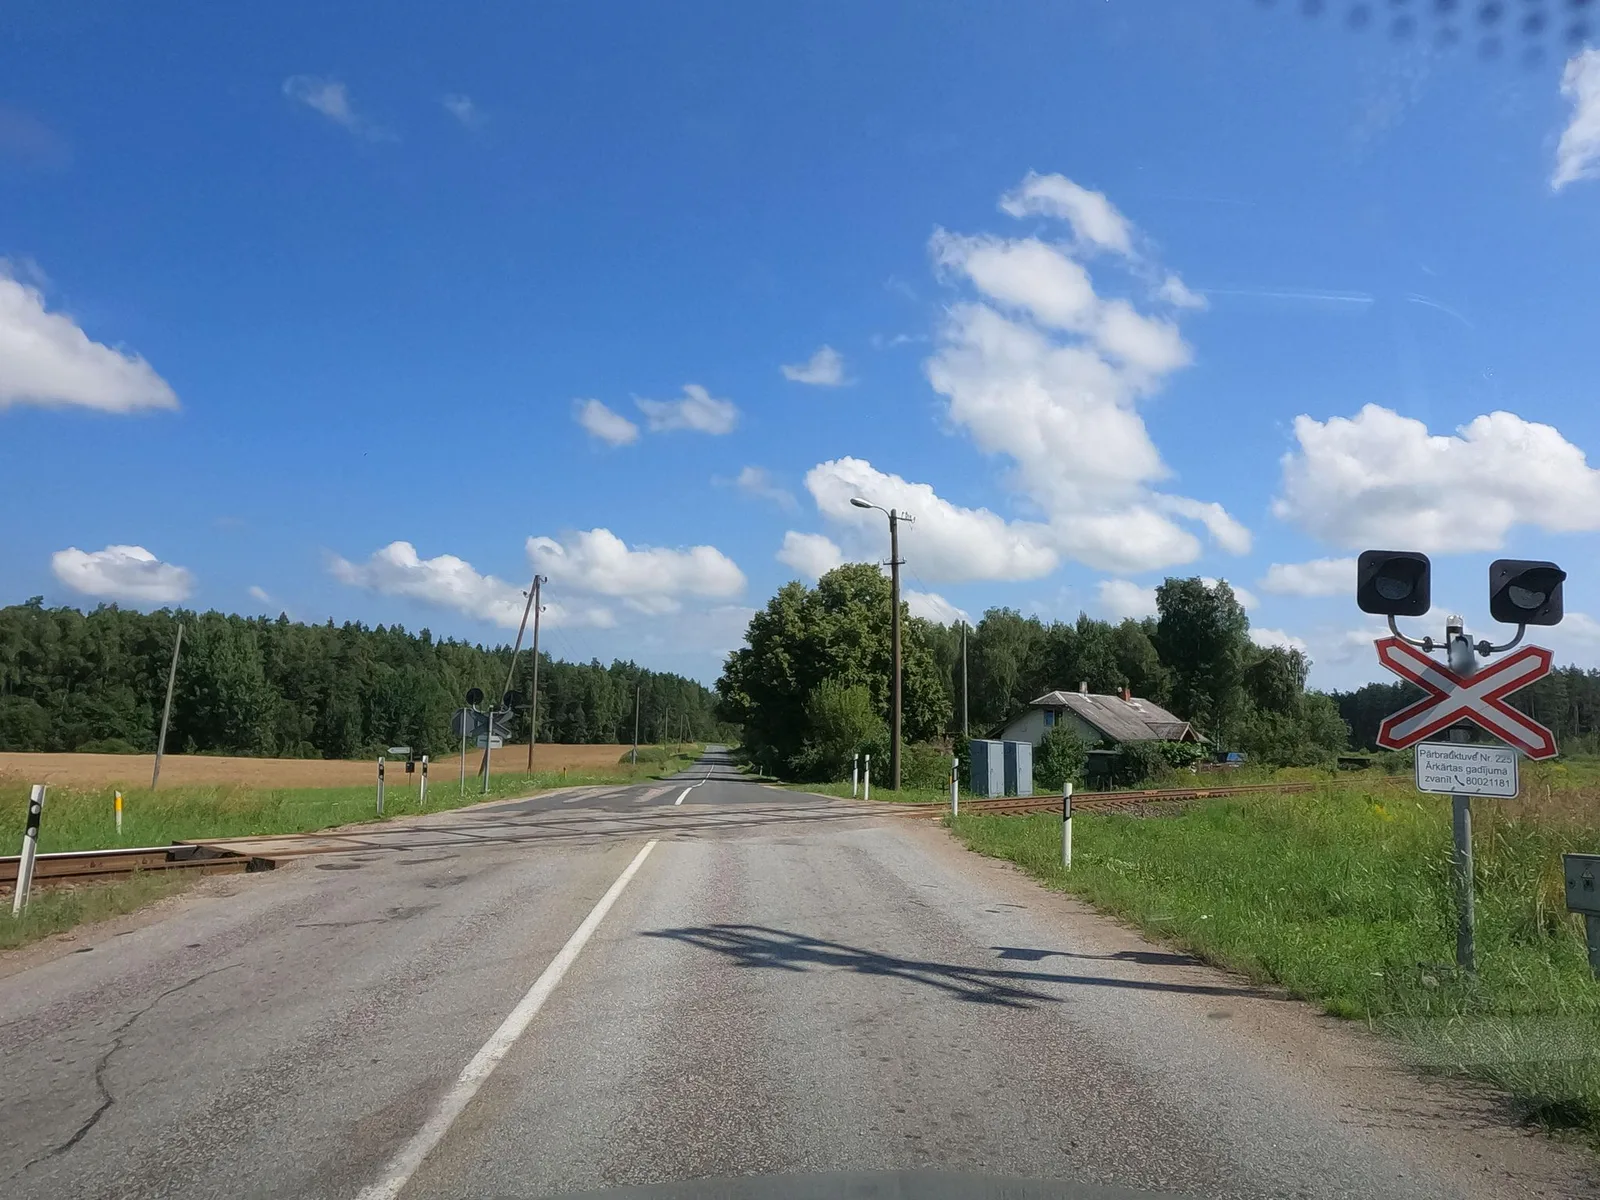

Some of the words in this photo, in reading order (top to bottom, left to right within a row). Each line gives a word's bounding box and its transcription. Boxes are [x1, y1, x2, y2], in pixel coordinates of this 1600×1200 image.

[1425, 760, 1463, 773] Ārkārtas
[1466, 765, 1508, 776] gadījumā
[1424, 775, 1452, 784] zvanīt
[1466, 776, 1510, 787] 80021181
